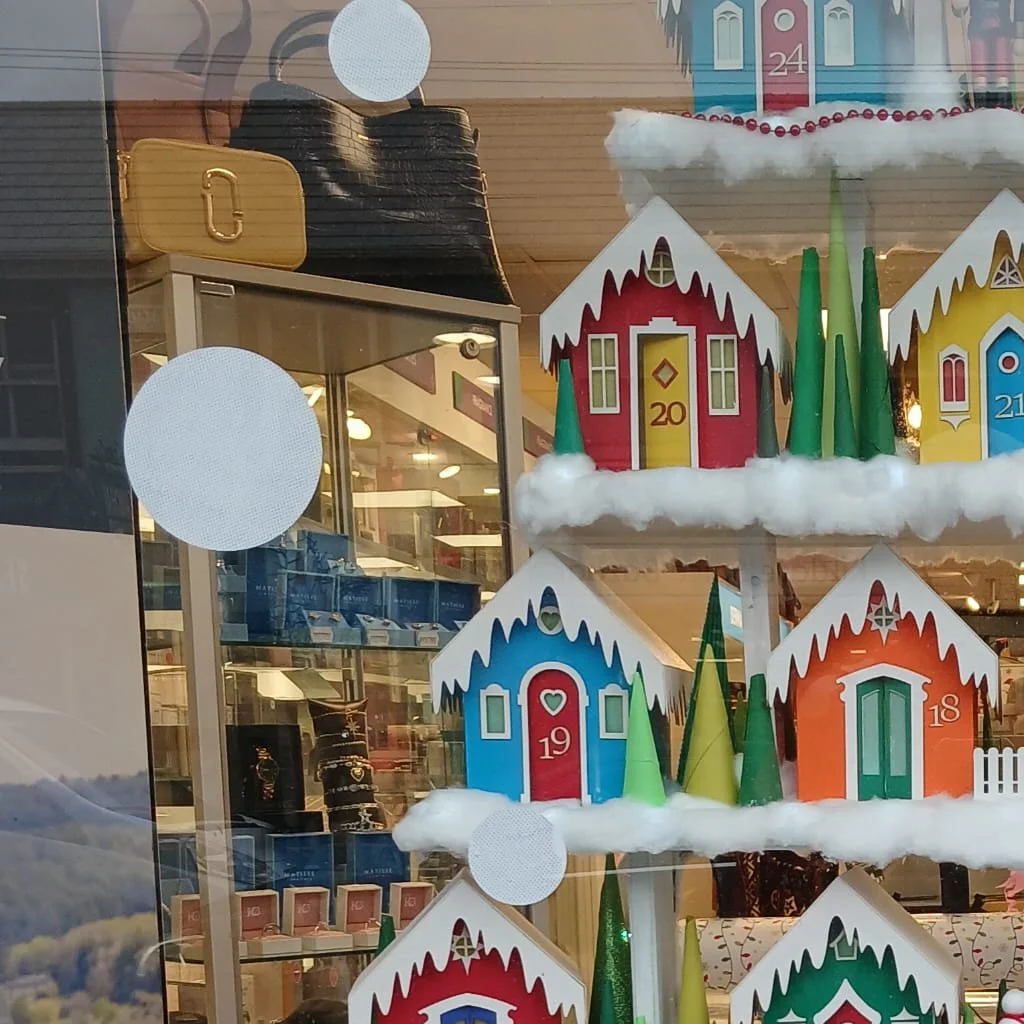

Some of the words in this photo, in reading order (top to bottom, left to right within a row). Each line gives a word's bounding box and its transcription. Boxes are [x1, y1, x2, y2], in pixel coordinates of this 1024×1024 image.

[768, 44, 807, 76] 24
[650, 402, 686, 426] 20
[929, 694, 960, 727] 18
[539, 727, 570, 760] 19
